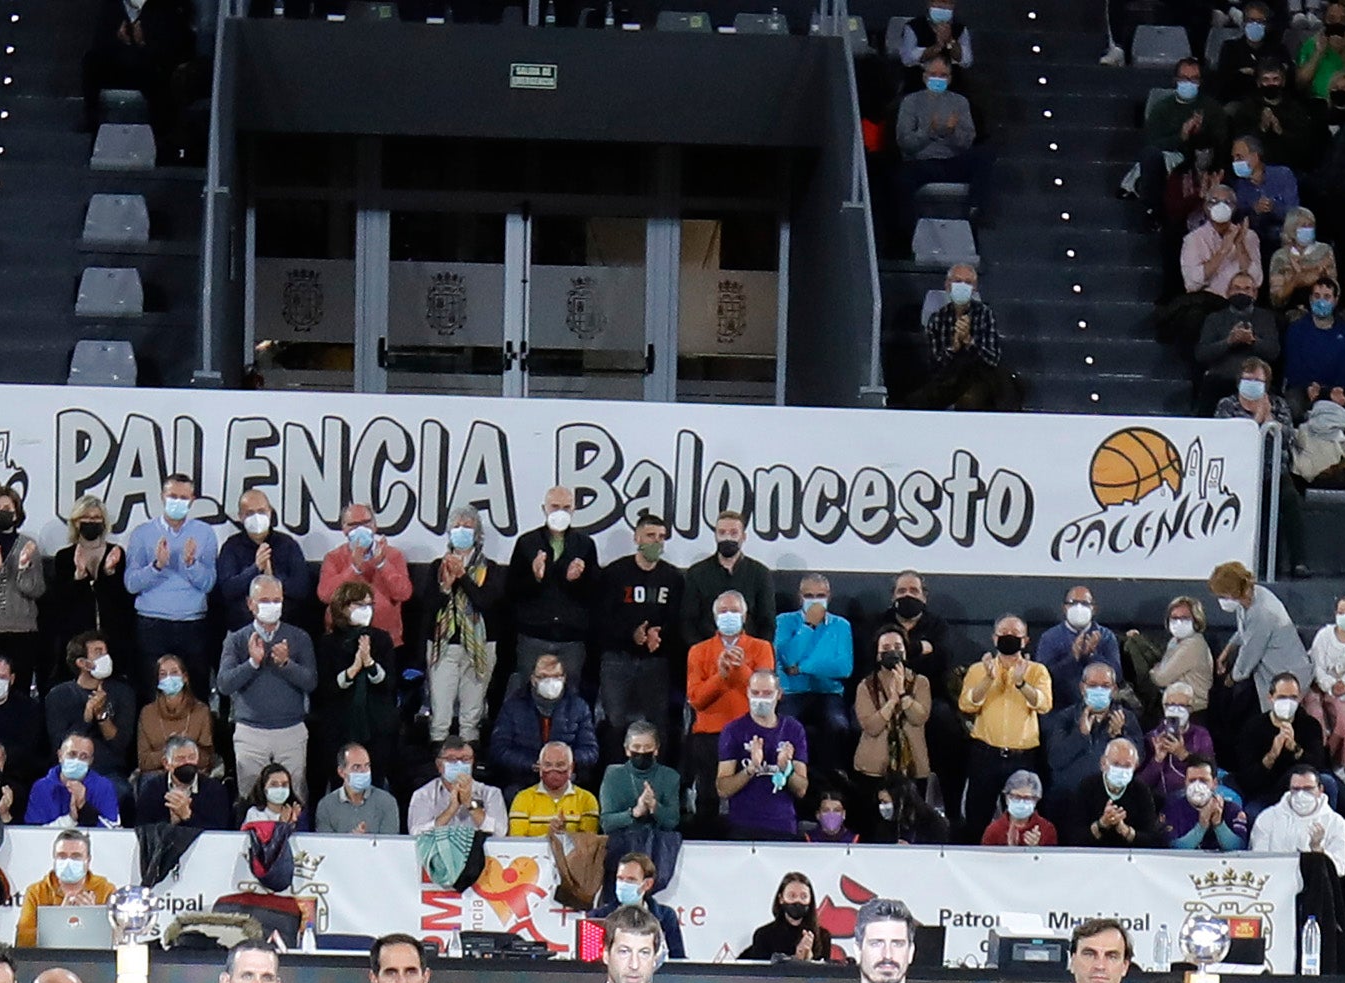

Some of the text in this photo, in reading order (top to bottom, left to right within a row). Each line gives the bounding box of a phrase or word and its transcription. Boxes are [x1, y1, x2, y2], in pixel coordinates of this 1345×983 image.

[54, 406, 522, 538] PALENCIA
[555, 423, 1036, 548] Baloncesto
[1050, 493, 1242, 562] PALENCIA
[624, 585, 670, 605] ZOE
[155, 892, 204, 915] cipal
[472, 899, 484, 931] ncia
